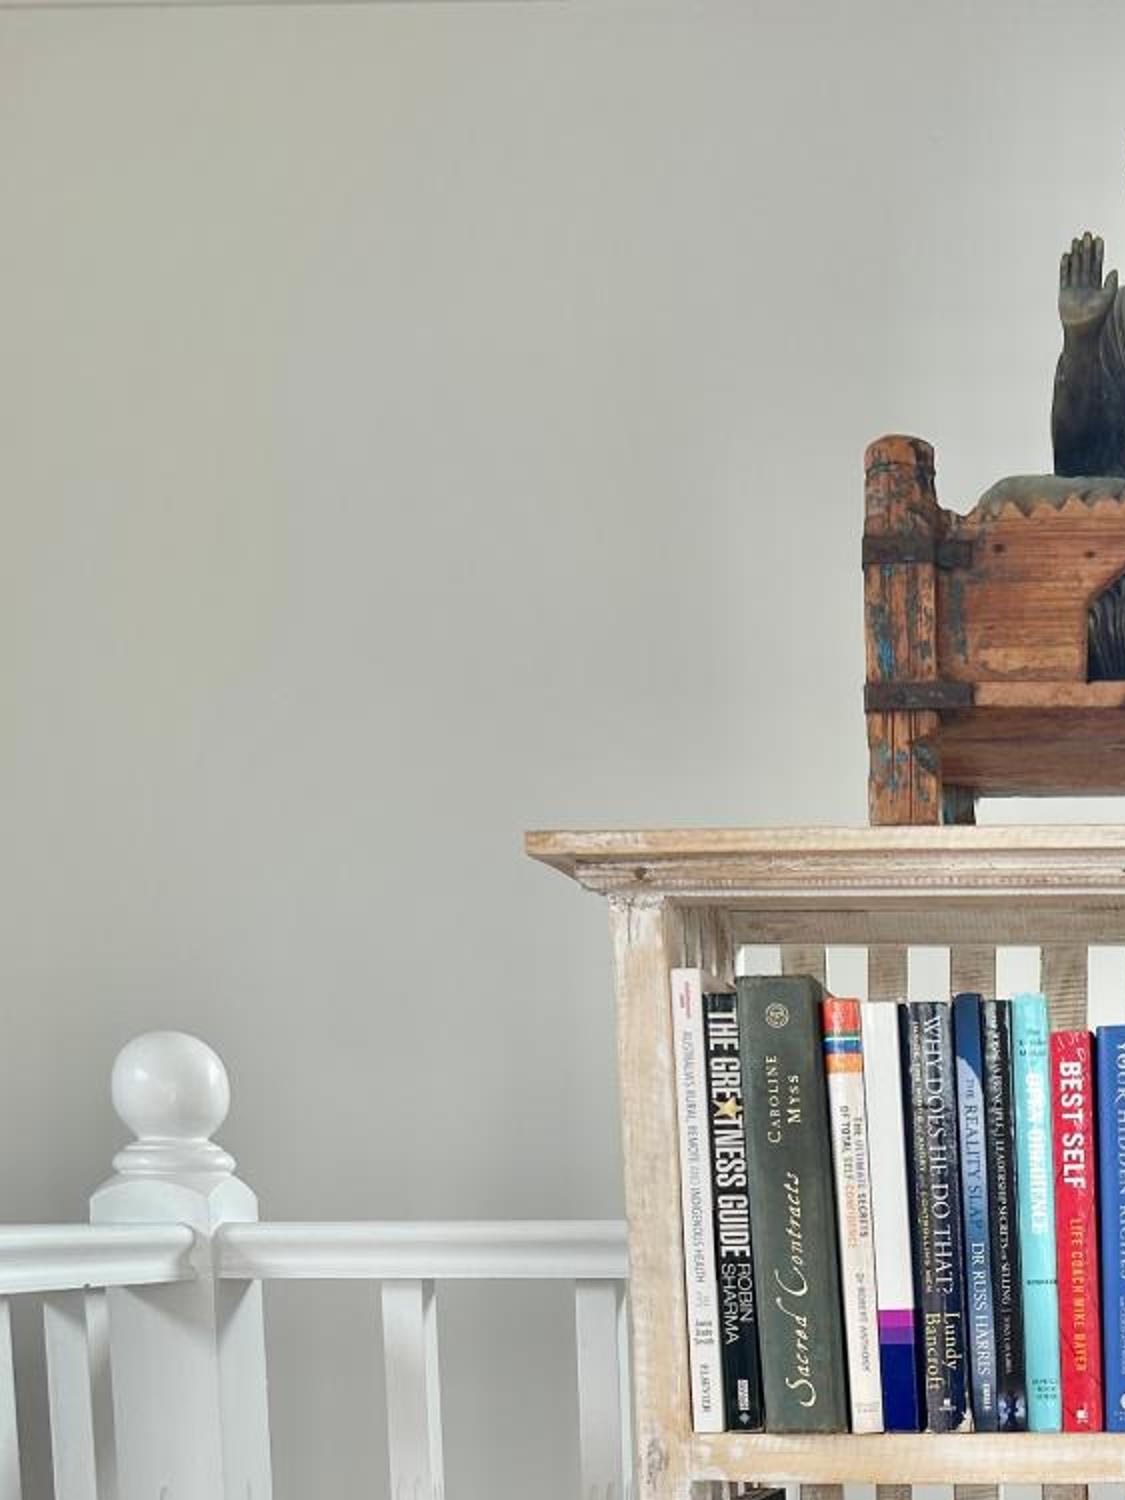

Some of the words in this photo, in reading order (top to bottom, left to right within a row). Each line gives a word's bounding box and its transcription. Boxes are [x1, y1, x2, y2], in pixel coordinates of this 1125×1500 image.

[707, 1008, 739, 1051] THE
[923, 1015, 944, 1071] WHY
[766, 1055, 781, 1143] CAROLINE
[788, 1073, 801, 1123] MYSS
[839, 1105, 849, 1119] OF
[926, 1079, 946, 1138] DOES
[965, 1078, 975, 1100] THE
[1059, 1061, 1084, 1124] BEST
[841, 1122, 852, 1153] TOTAL
[853, 1116, 863, 1136] THE
[964, 1105, 982, 1179] REALITY
[843, 1157, 854, 1180] SELF
[854, 1138, 866, 1188] ULTIMATE
[929, 1145, 947, 1177] HE
[995, 1141, 1008, 1204] LEADERSHIP
[1062, 1133, 1087, 1189] SELF
[690, 1187, 703, 1247] INDIGENOUS
[717, 1194, 751, 1258] GUIDE
[846, 1183, 859, 1249] CONFIDENCE
[857, 1192, 869, 1238] SECRETS
[931, 1184, 951, 1219] DO
[967, 1184, 986, 1238] SLAP
[774, 1171, 808, 1297] Contracts
[934, 1224, 954, 1294] THAT?
[970, 1242, 985, 1264] DR
[1069, 1217, 1083, 1248] LIFE
[695, 1249, 704, 1283] HEALTH
[737, 1263, 754, 1321] ROBIN
[972, 1269, 988, 1310] RUSS
[1001, 1263, 1012, 1305] SELLING
[1071, 1251, 1086, 1294] COACH
[720, 1263, 740, 1344] SHARMA
[1073, 1297, 1087, 1328] MIKE
[776, 1297, 816, 1407] Sacred
[924, 1312, 944, 1391] Bancroft
[941, 1312, 963, 1371] Lundy
[975, 1315, 991, 1376] HARRIS
